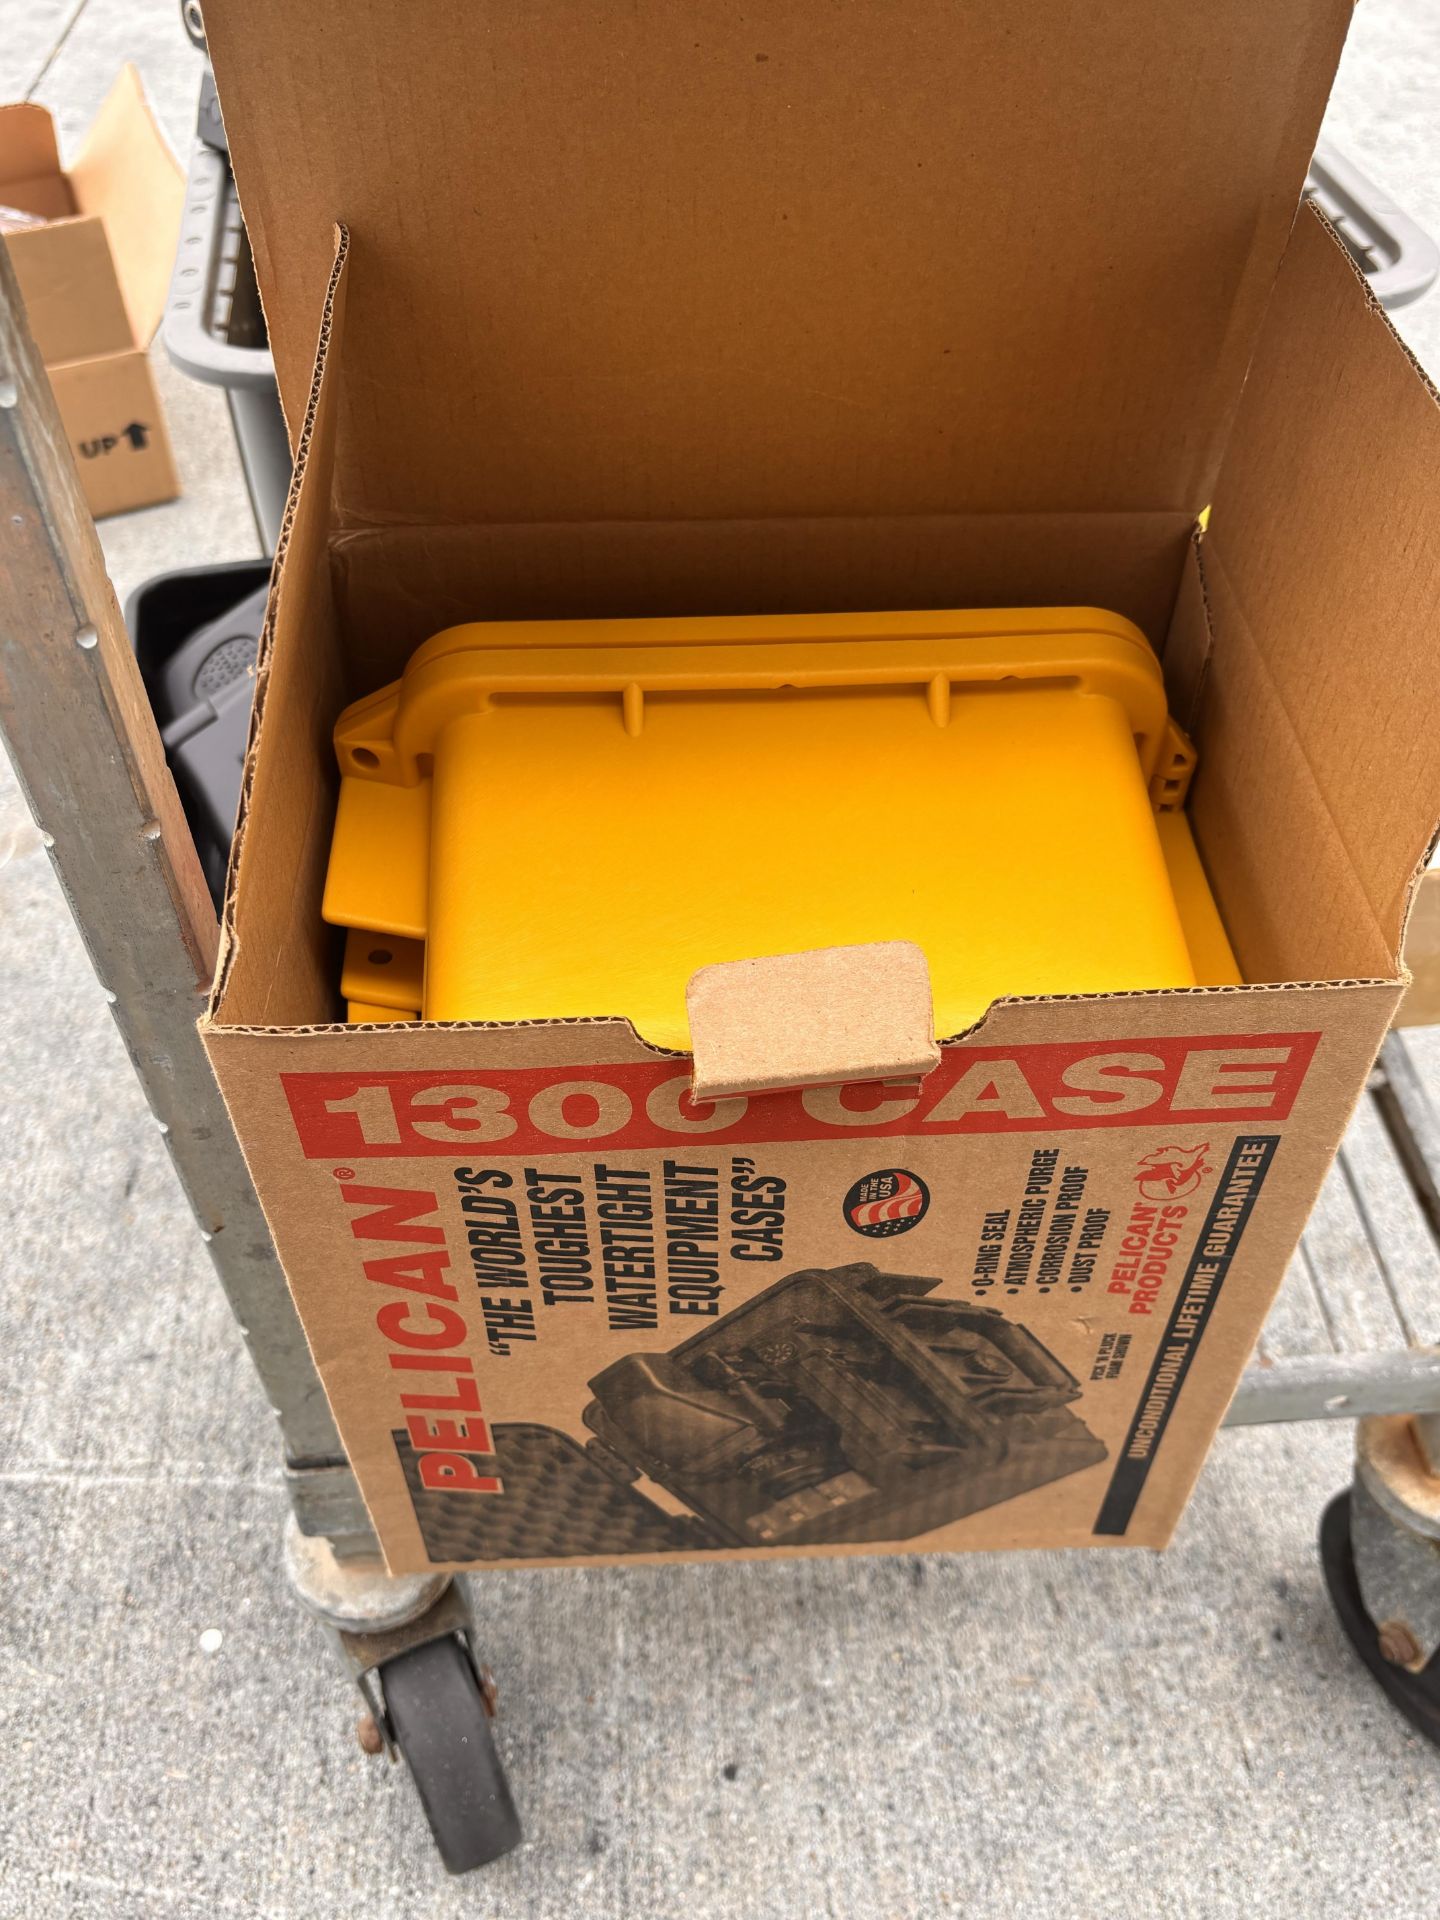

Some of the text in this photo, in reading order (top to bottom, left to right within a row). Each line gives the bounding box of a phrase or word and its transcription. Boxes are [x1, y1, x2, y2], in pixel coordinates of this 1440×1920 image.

[79, 436, 118, 459] UP
[324, 1047, 1292, 1144] 1300 CASE
[454, 1167, 528, 1287] WORLD'S
[524, 1168, 594, 1305] TOUGHEST
[663, 1160, 726, 1315] EQUIPMENT
[860, 1184, 869, 1202] MADE
[869, 1178, 879, 1200] IN THE
[879, 1176, 893, 1198] USA
[1004, 1148, 1060, 1286] ATMOSPHERIC PURGE
[1036, 1166, 1089, 1284] CORROSION PROOF
[594, 1164, 658, 1330] WATERTIGHT
[971, 1209, 1011, 1287] O-RING SEAL
[1067, 1208, 1111, 1284] DUST PROOF
[1127, 1141, 1268, 1459] UNCONDITIONAL LIFETIME GUARANTEE
[1128, 1205, 1189, 1315] PRODUCTS
